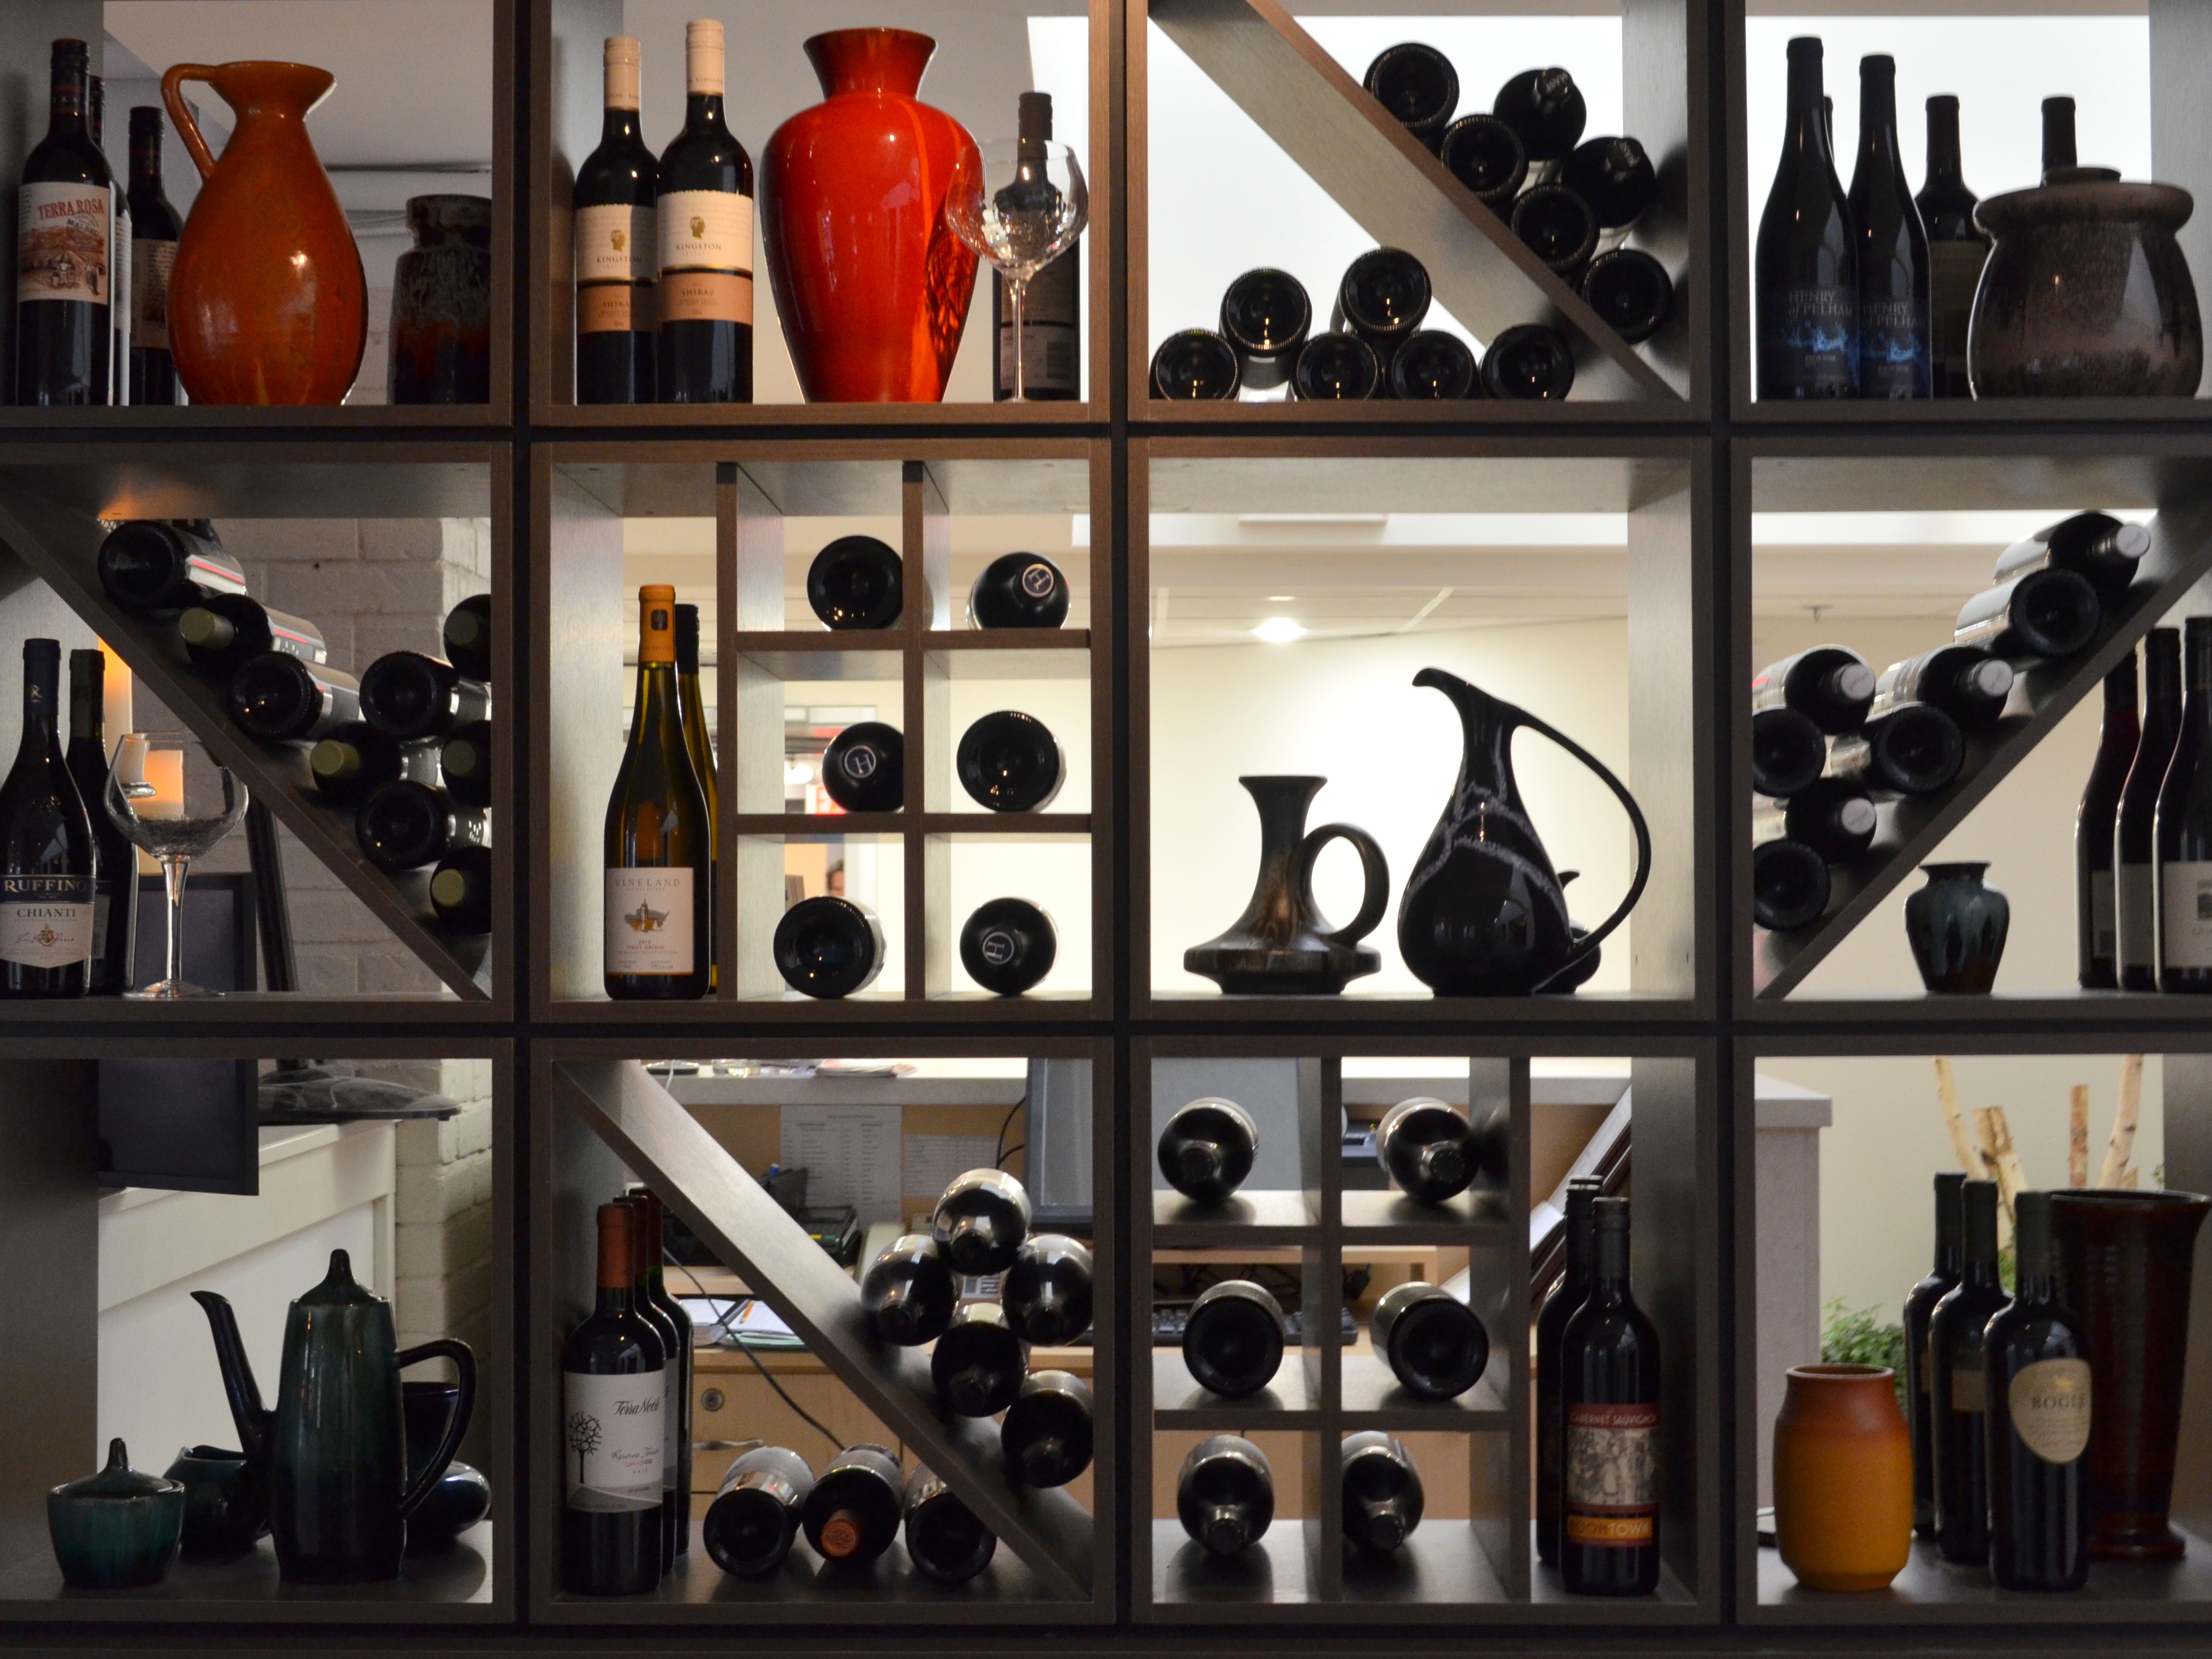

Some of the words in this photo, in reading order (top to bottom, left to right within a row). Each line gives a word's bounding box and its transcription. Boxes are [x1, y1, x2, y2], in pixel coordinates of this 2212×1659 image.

[37, 201, 75, 220] TERRA
[76, 198, 105, 214] ROSA
[597, 255, 642, 264] KINGSTON
[1789, 290, 1836, 303] HENRY
[1803, 304, 1852, 316] PELHAM
[854, 753, 874, 774] H
[5, 879, 86, 892] RUFFINO
[615, 879, 680, 887] VINELAND
[17, 908, 76, 918] CHIANTI
